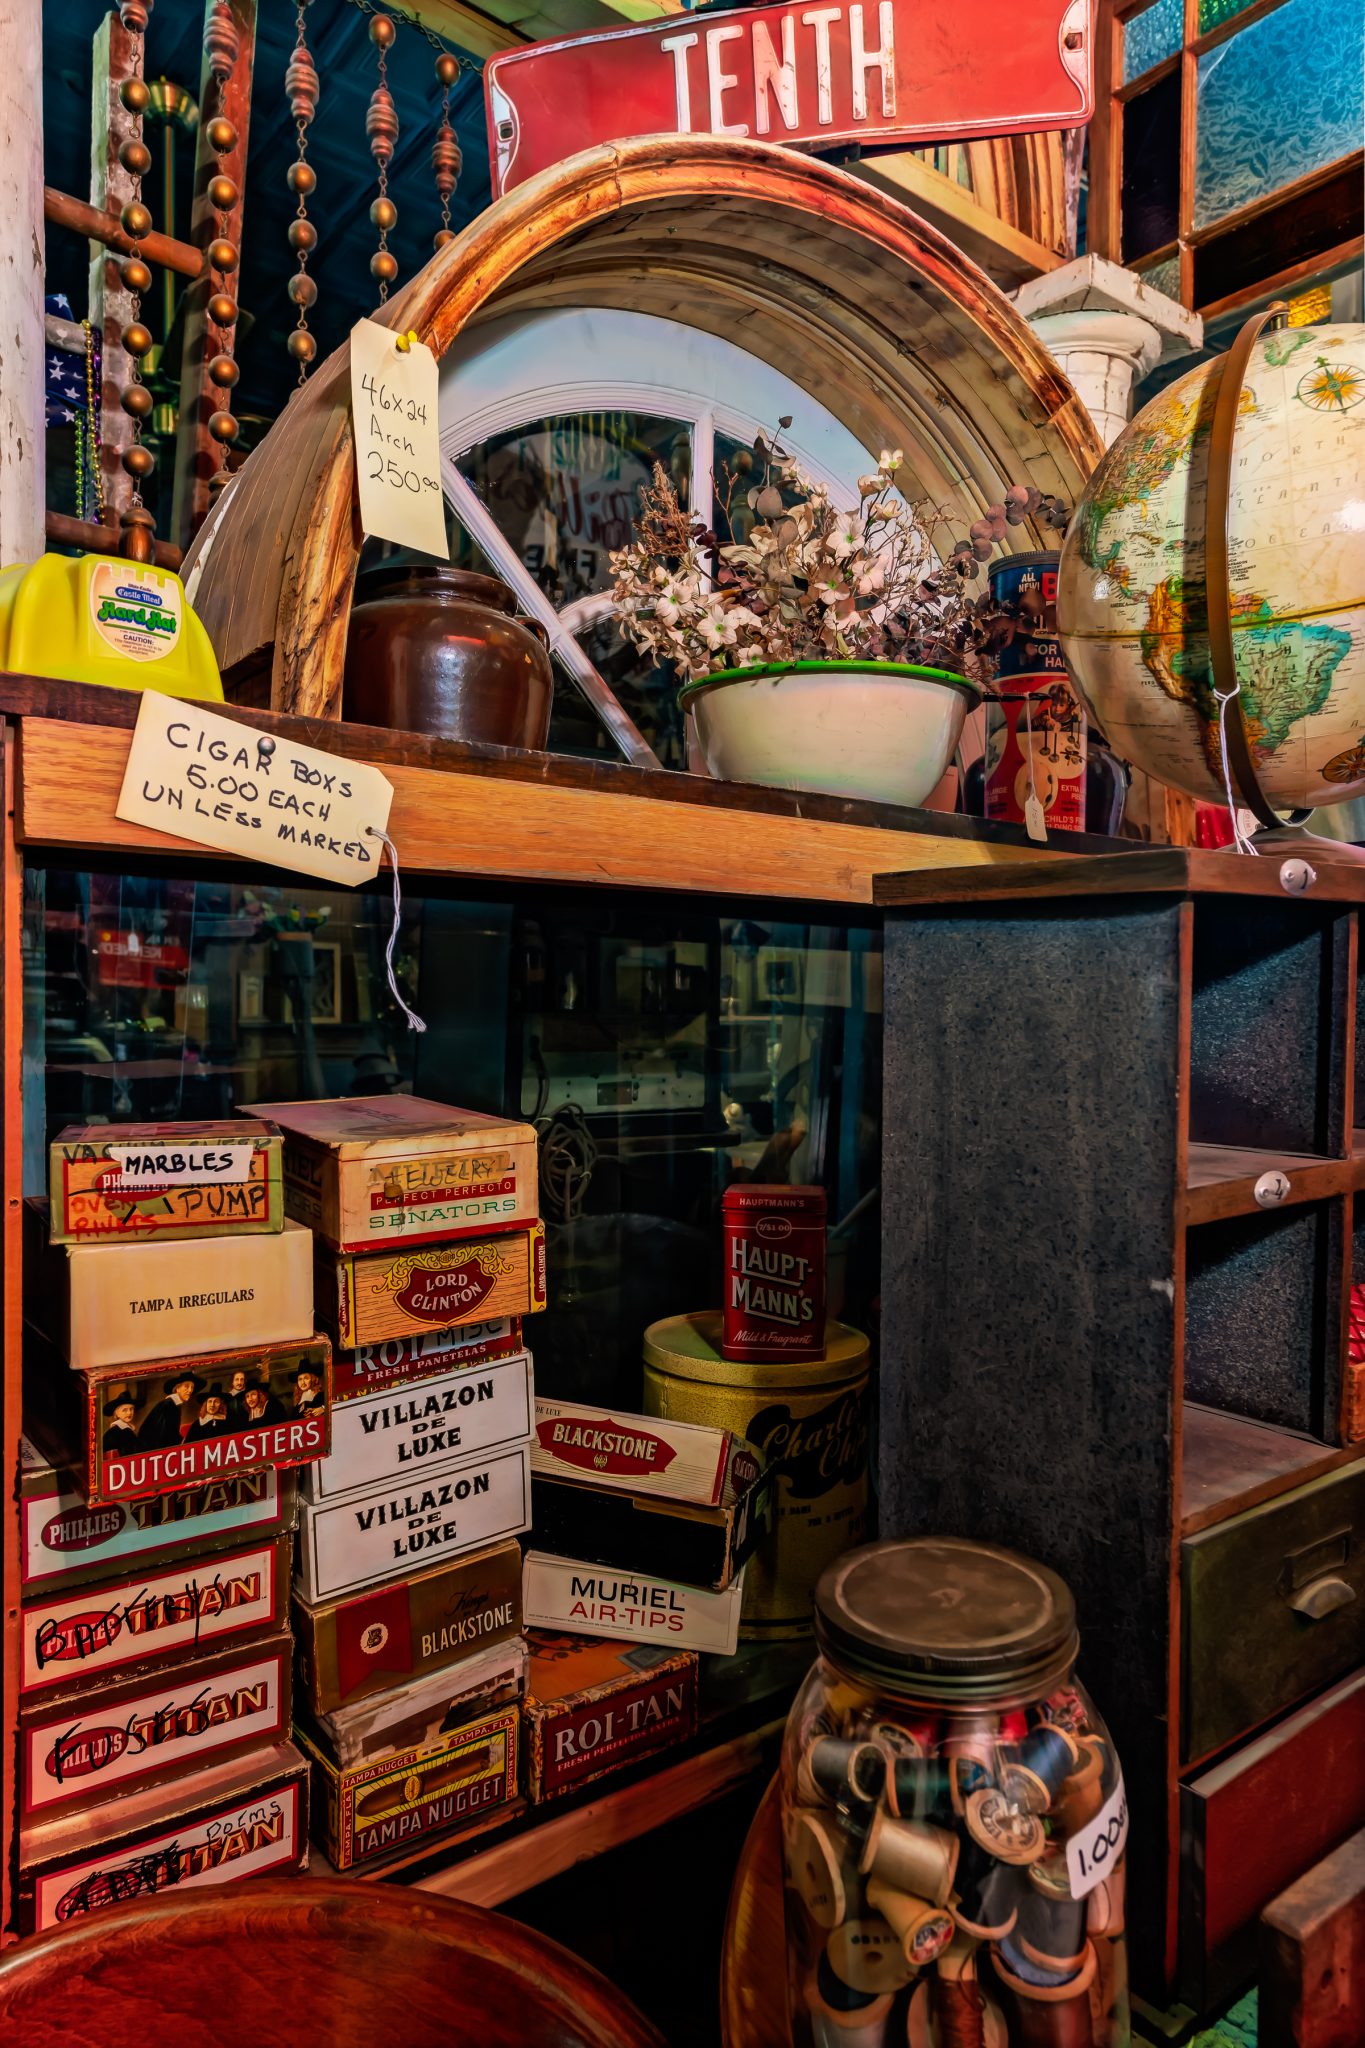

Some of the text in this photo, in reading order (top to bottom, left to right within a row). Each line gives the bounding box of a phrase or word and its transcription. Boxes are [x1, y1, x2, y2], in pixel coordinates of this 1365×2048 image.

[661, 1, 896, 137] TENTH
[370, 413, 415, 456] Arch
[1237, 473, 1359, 508] TLANTI
[1021, 572, 1036, 582] ALL
[97, 600, 177, 634] Hard Hat
[166, 723, 353, 798] CIGAR BOXS
[186, 763, 331, 822] 5.00 EACH
[277, 823, 371, 863] MARKED
[125, 1152, 233, 1176] MARBLES
[178, 1186, 266, 1219] PUMP
[445, 1180, 512, 1196] PERFECTO
[739, 1197, 805, 1208] HAUPTMANN'S
[369, 1199, 516, 1229] SENATORS
[731, 1236, 814, 1282] HAUPT-
[130, 1288, 255, 1314] TAMPA IRREGULARS
[411, 1282, 483, 1311] CLINTON
[426, 1273, 468, 1292] LORD
[731, 1275, 814, 1322] MANN'S
[733, 1329, 759, 1343] Mild
[768, 1331, 813, 1347] Fragrant
[367, 1344, 487, 1382] FRESH PANETELAS
[359, 1379, 494, 1434] VILLAZON
[412, 1416, 446, 1435] DE
[108, 1421, 320, 1491] DUTCH MASTERS
[398, 1426, 462, 1463] LUXE
[552, 1423, 658, 1462] BLACKSTONE
[49, 1472, 267, 1545] PHILLIES TITAN
[355, 1472, 490, 1532] VILLAZON
[407, 1511, 442, 1531] DE
[393, 1521, 457, 1559] LUXE
[128, 1571, 260, 1637] TITAN
[571, 1576, 686, 1612] MURIEL
[422, 1602, 513, 1658] BLACKSTONE
[569, 1601, 684, 1632] AIR-TIPS
[132, 1681, 268, 1749] TITAN
[554, 1683, 684, 1763] ROI-TAN
[54, 1687, 212, 1784] FUSES
[558, 1716, 680, 1773] FRESH PERFECTOS EXTRA
[344, 1754, 416, 1787] TAMPA NUGGET
[358, 1776, 502, 1853] TAMPA NUGGET
